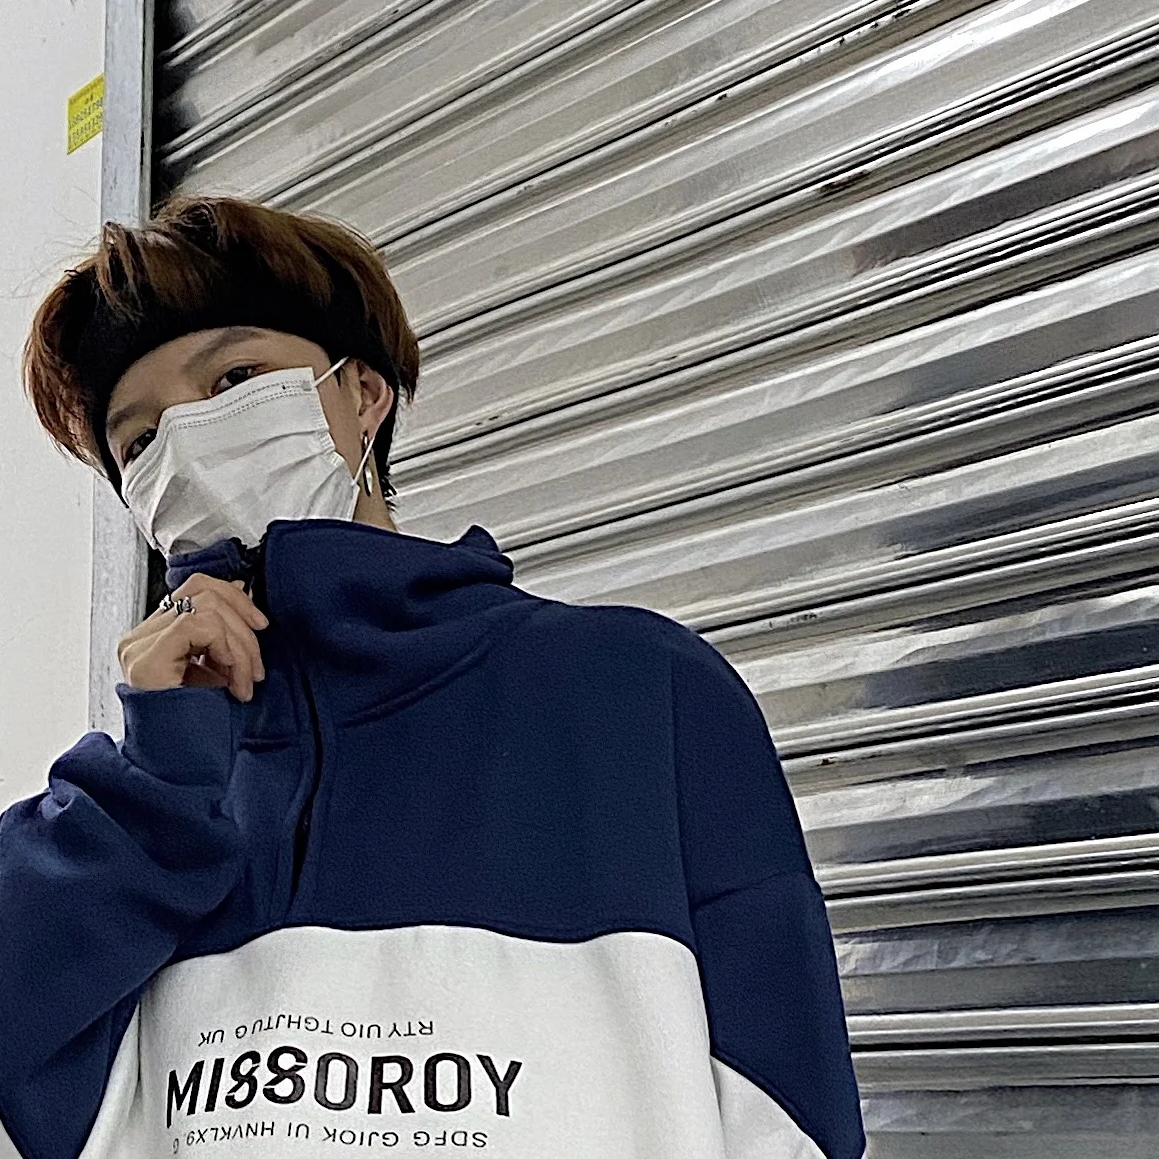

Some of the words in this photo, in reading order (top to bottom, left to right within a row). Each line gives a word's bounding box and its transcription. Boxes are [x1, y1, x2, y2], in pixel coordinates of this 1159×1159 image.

[197, 1029, 225, 1047] UK
[340, 1022, 381, 1039] UIO
[388, 1020, 434, 1038] RTY
[287, 1122, 310, 1139] UI
[323, 1126, 399, 1147] GJIOK
[413, 1130, 488, 1148] SDFG
